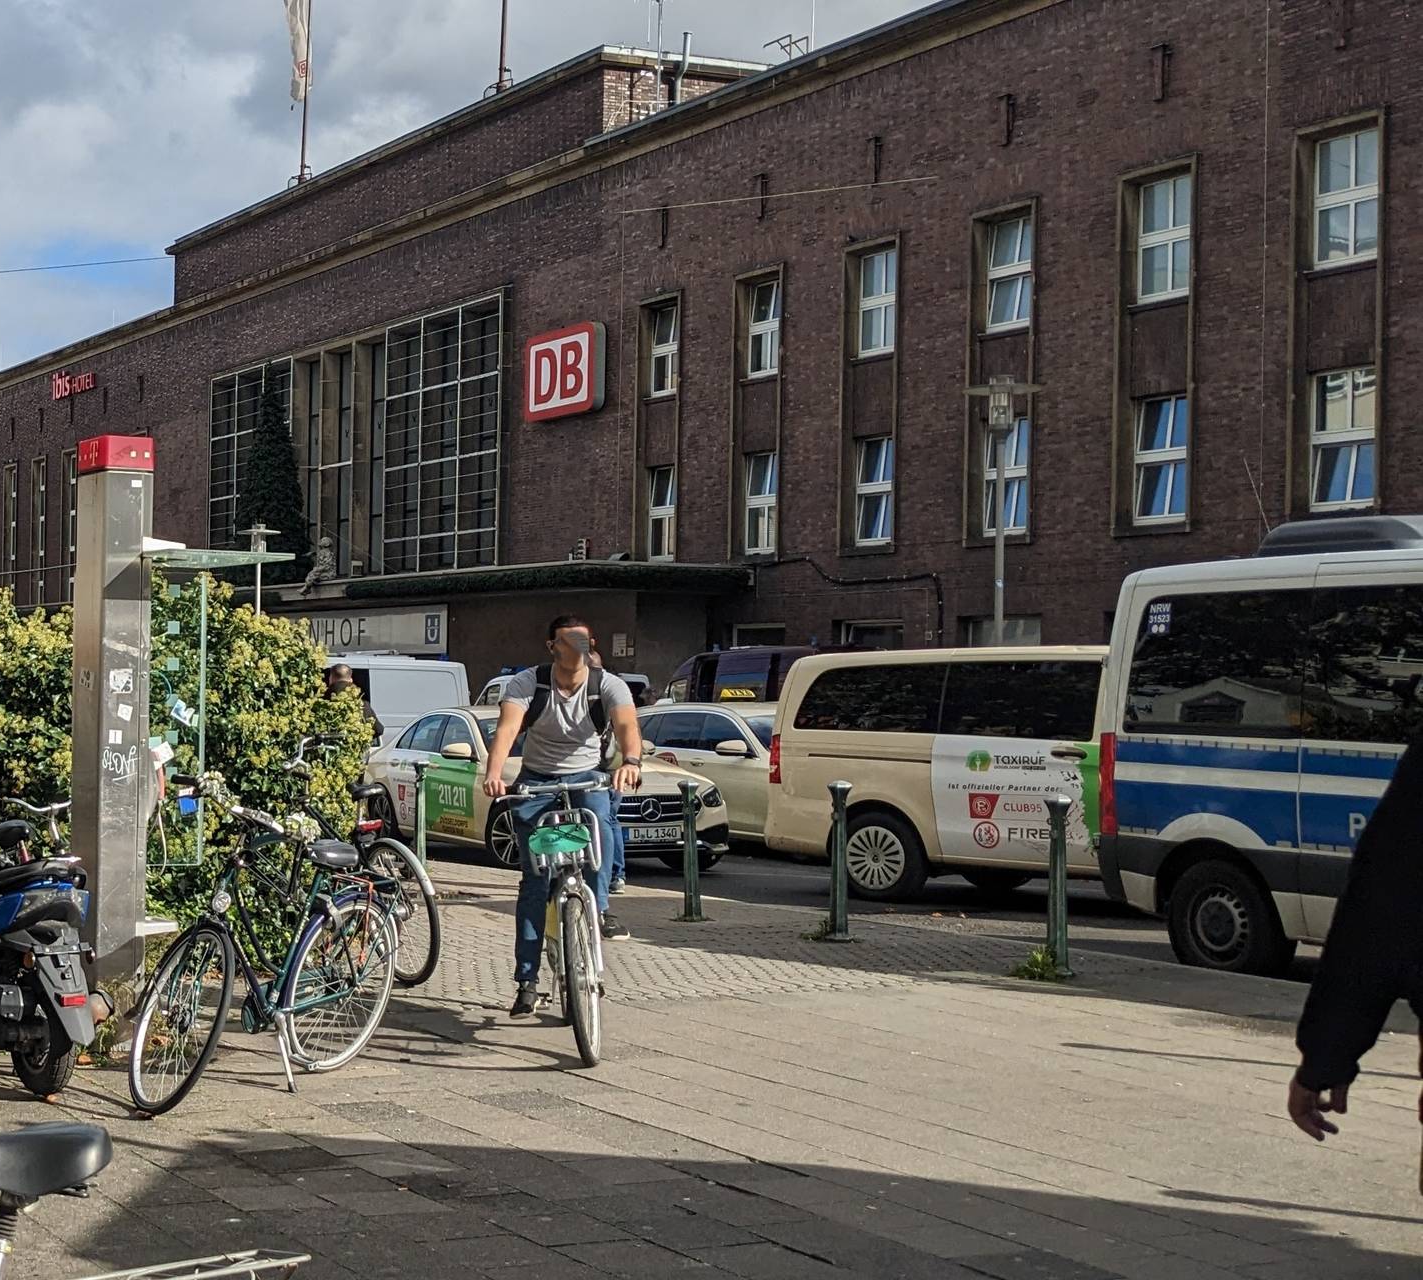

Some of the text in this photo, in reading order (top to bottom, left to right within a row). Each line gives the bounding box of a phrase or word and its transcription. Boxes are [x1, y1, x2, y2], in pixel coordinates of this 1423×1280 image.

[52, 371, 94, 400] ibis HOTEL
[534, 341, 583, 405] DB
[1148, 614, 1170, 624] 31523
[1149, 603, 1171, 613] NRW
[308, 618, 366, 646] NHOF
[438, 783, 452, 806] 211
[453, 785, 467, 808] 211
[962, 783, 1004, 792] offizieller
[1007, 784, 1041, 793] Partner
[1003, 802, 1042, 813] CLUB95
[1349, 812, 1367, 839] P
